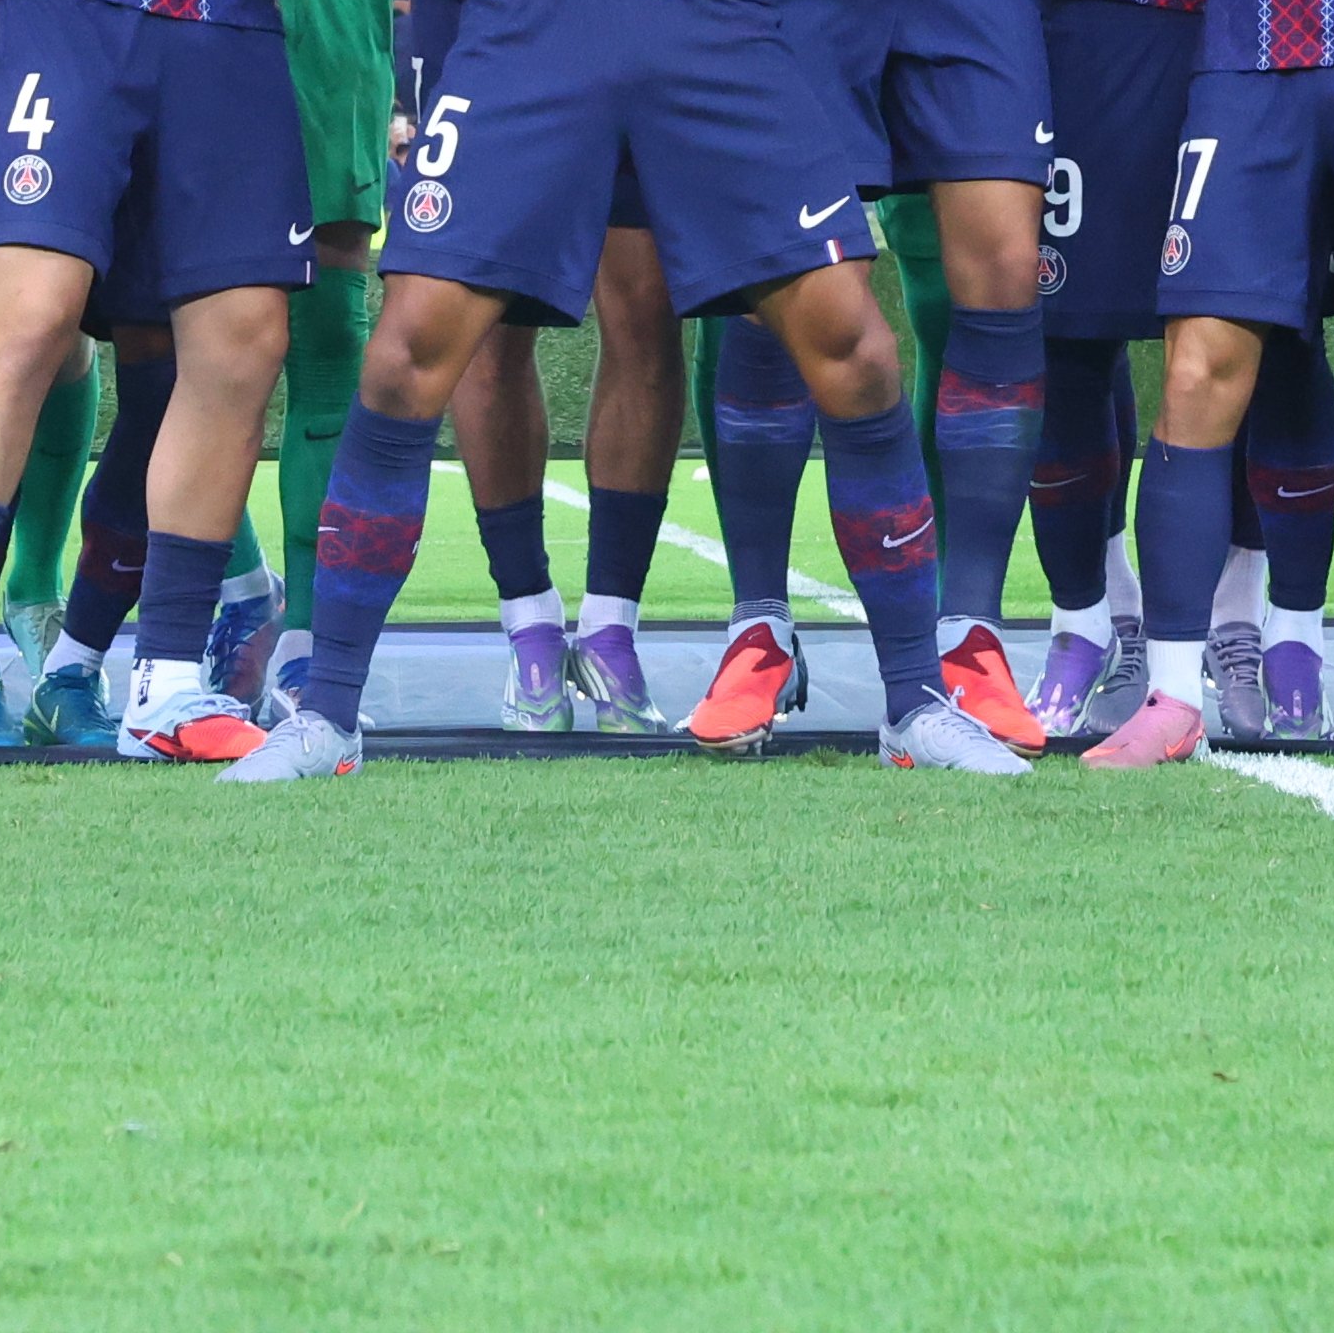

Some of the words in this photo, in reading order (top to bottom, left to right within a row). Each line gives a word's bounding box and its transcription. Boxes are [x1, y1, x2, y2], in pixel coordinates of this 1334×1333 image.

[7, 73, 56, 152] 4
[415, 94, 471, 179] 5
[12, 155, 43, 171] PARIS
[412, 180, 445, 199] PARIS
